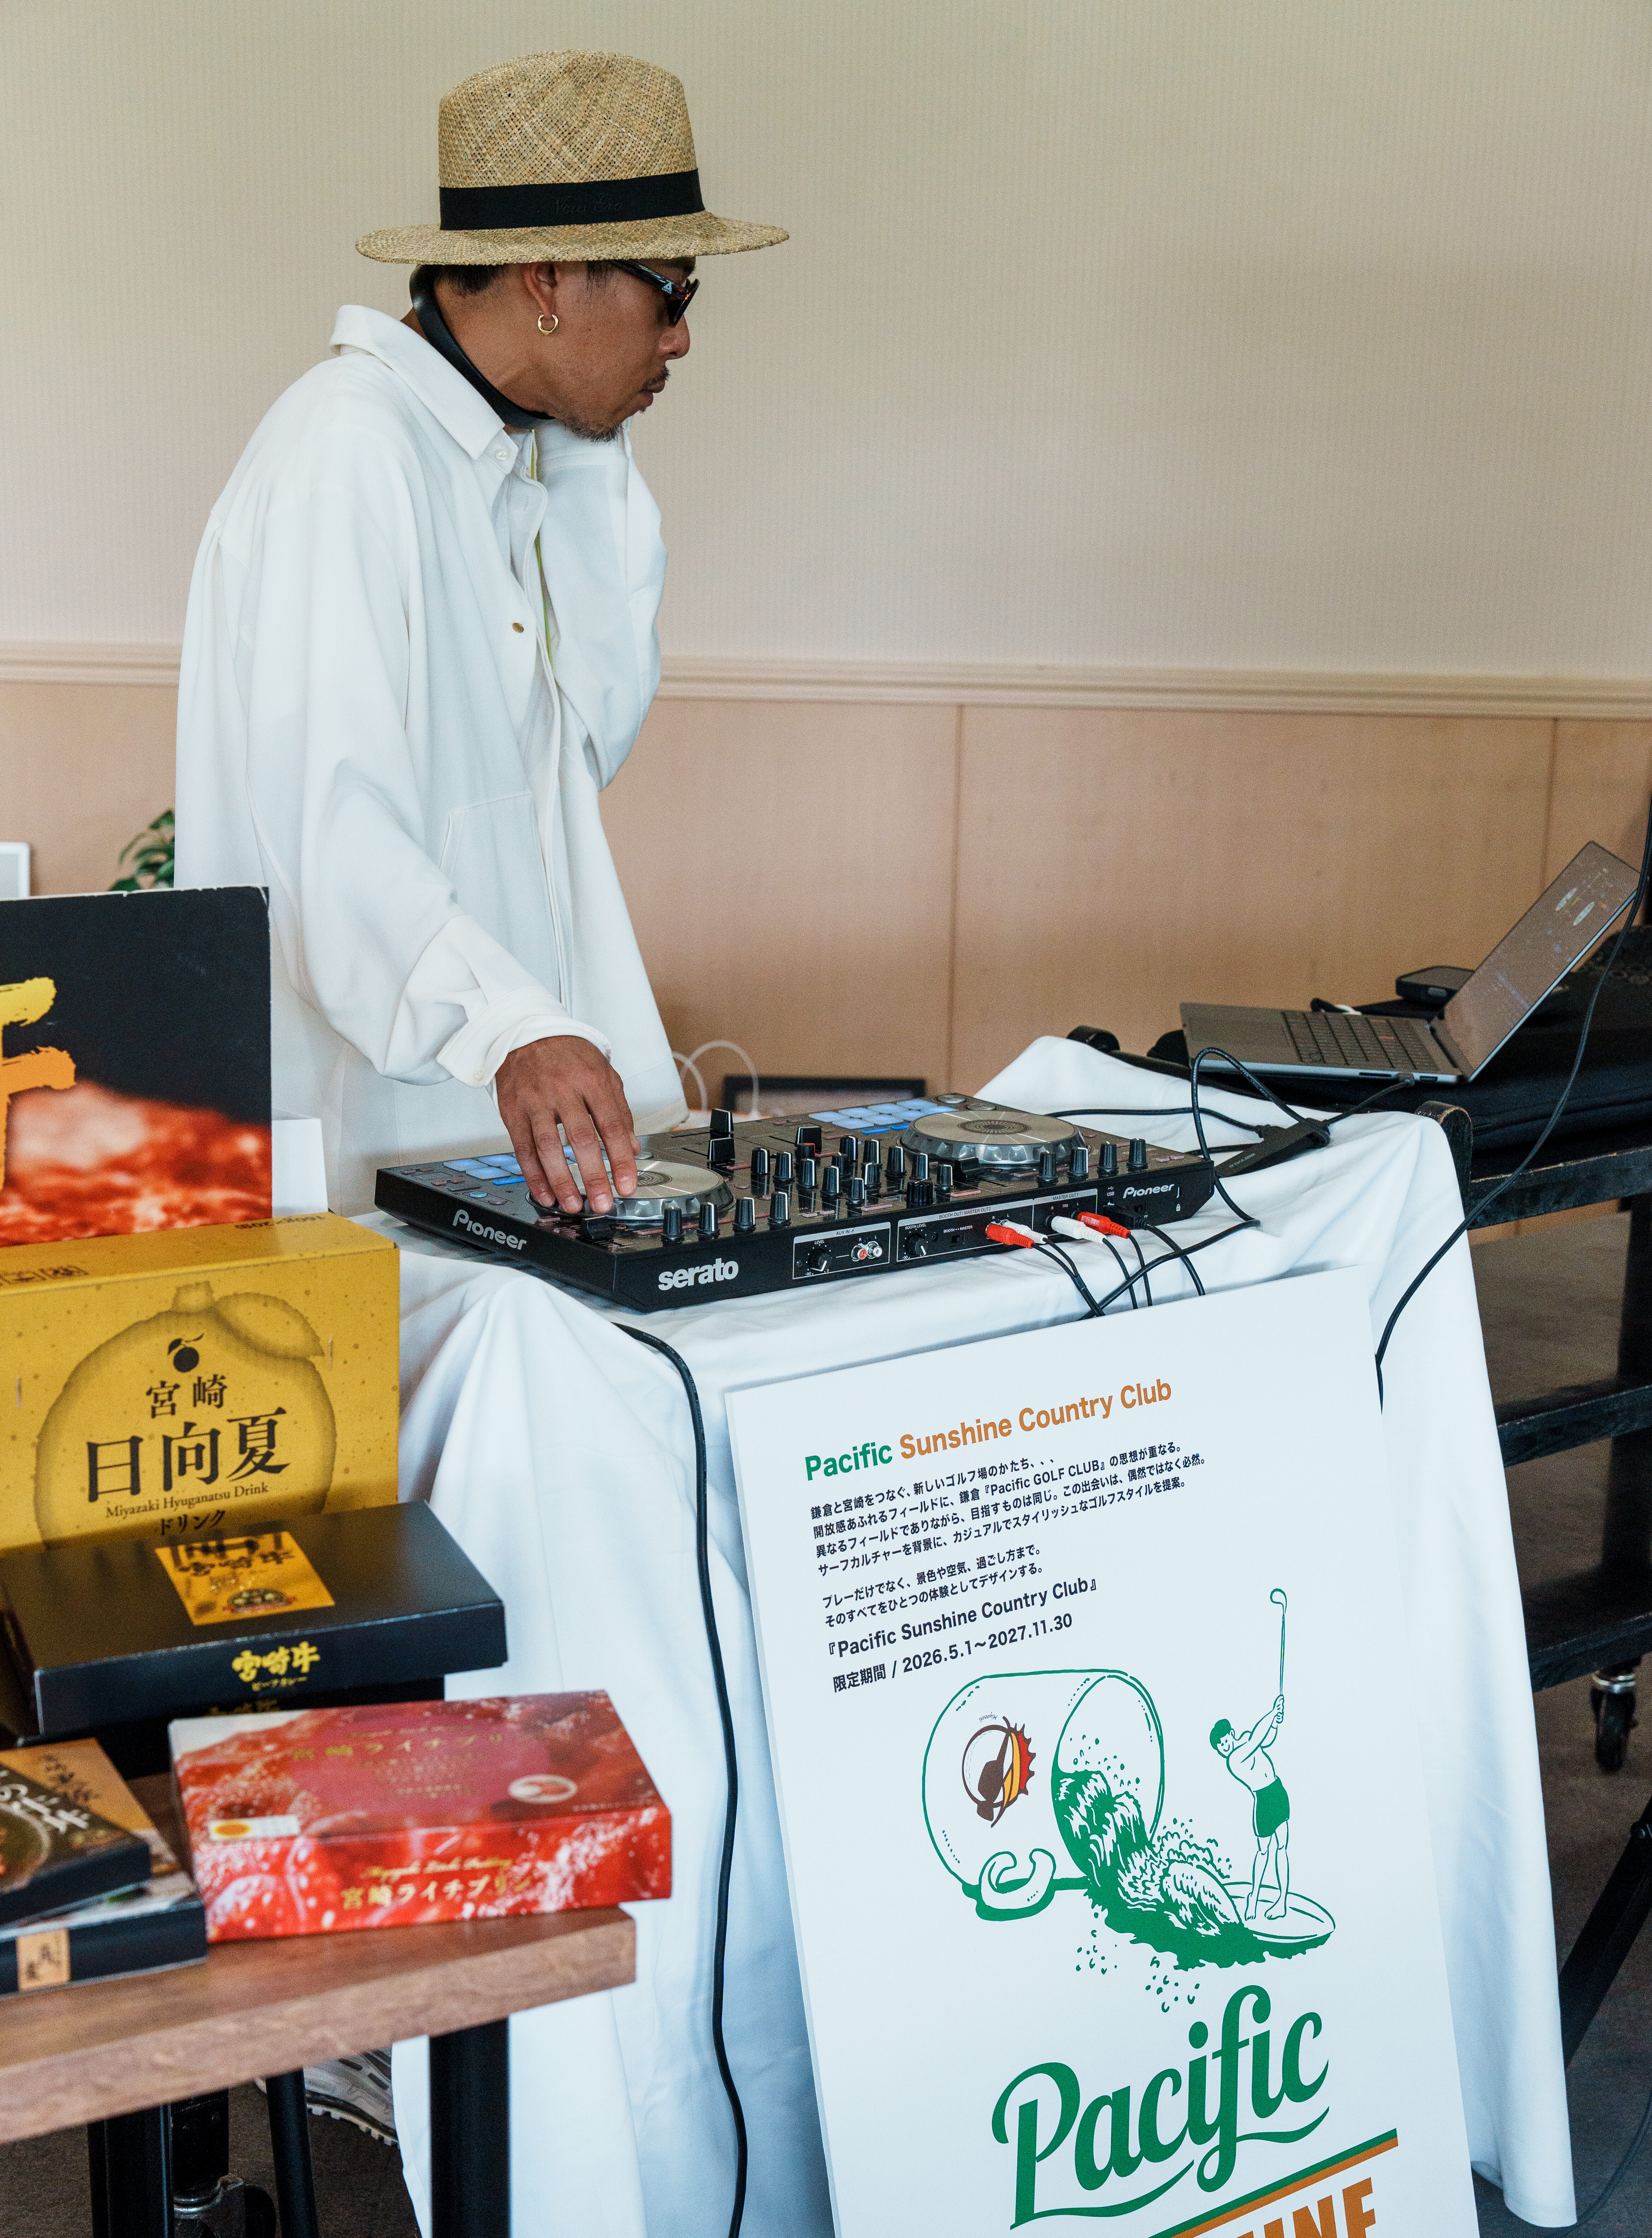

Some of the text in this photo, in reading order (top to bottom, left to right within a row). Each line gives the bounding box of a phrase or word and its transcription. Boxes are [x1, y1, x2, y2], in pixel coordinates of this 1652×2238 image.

[1123, 1183, 1174, 1199] Pioneer
[452, 1209, 527, 1250] Pioneer
[658, 1258, 739, 1290] serato
[666, 1345, 675, 1354] Pro
[146, 1374, 228, 1419] 宮崎
[805, 1379, 1171, 1481] Pacific Sunshine Country Club
[87, 1407, 290, 1503] 日向夏
[1033, 1467, 1065, 1485] GOLF
[106, 1482, 269, 1520] Miyazaki Hyuganatsu Drink
[160, 1509, 226, 1536] ドリンク
[822, 1544, 1040, 1609] プレーだけでなく、景色や空気、過ごし方まで。
[825, 1562, 1042, 1627] そのすべてをひとつの体験としてデザインする。
[828, 1577, 1097, 1658] 『Pacific Sunshine Country Club』
[833, 1663, 886, 1693] 限定期間
[978, 1711, 998, 1724] Miyazaki
[991, 1985, 1329, 2230] Pacific
